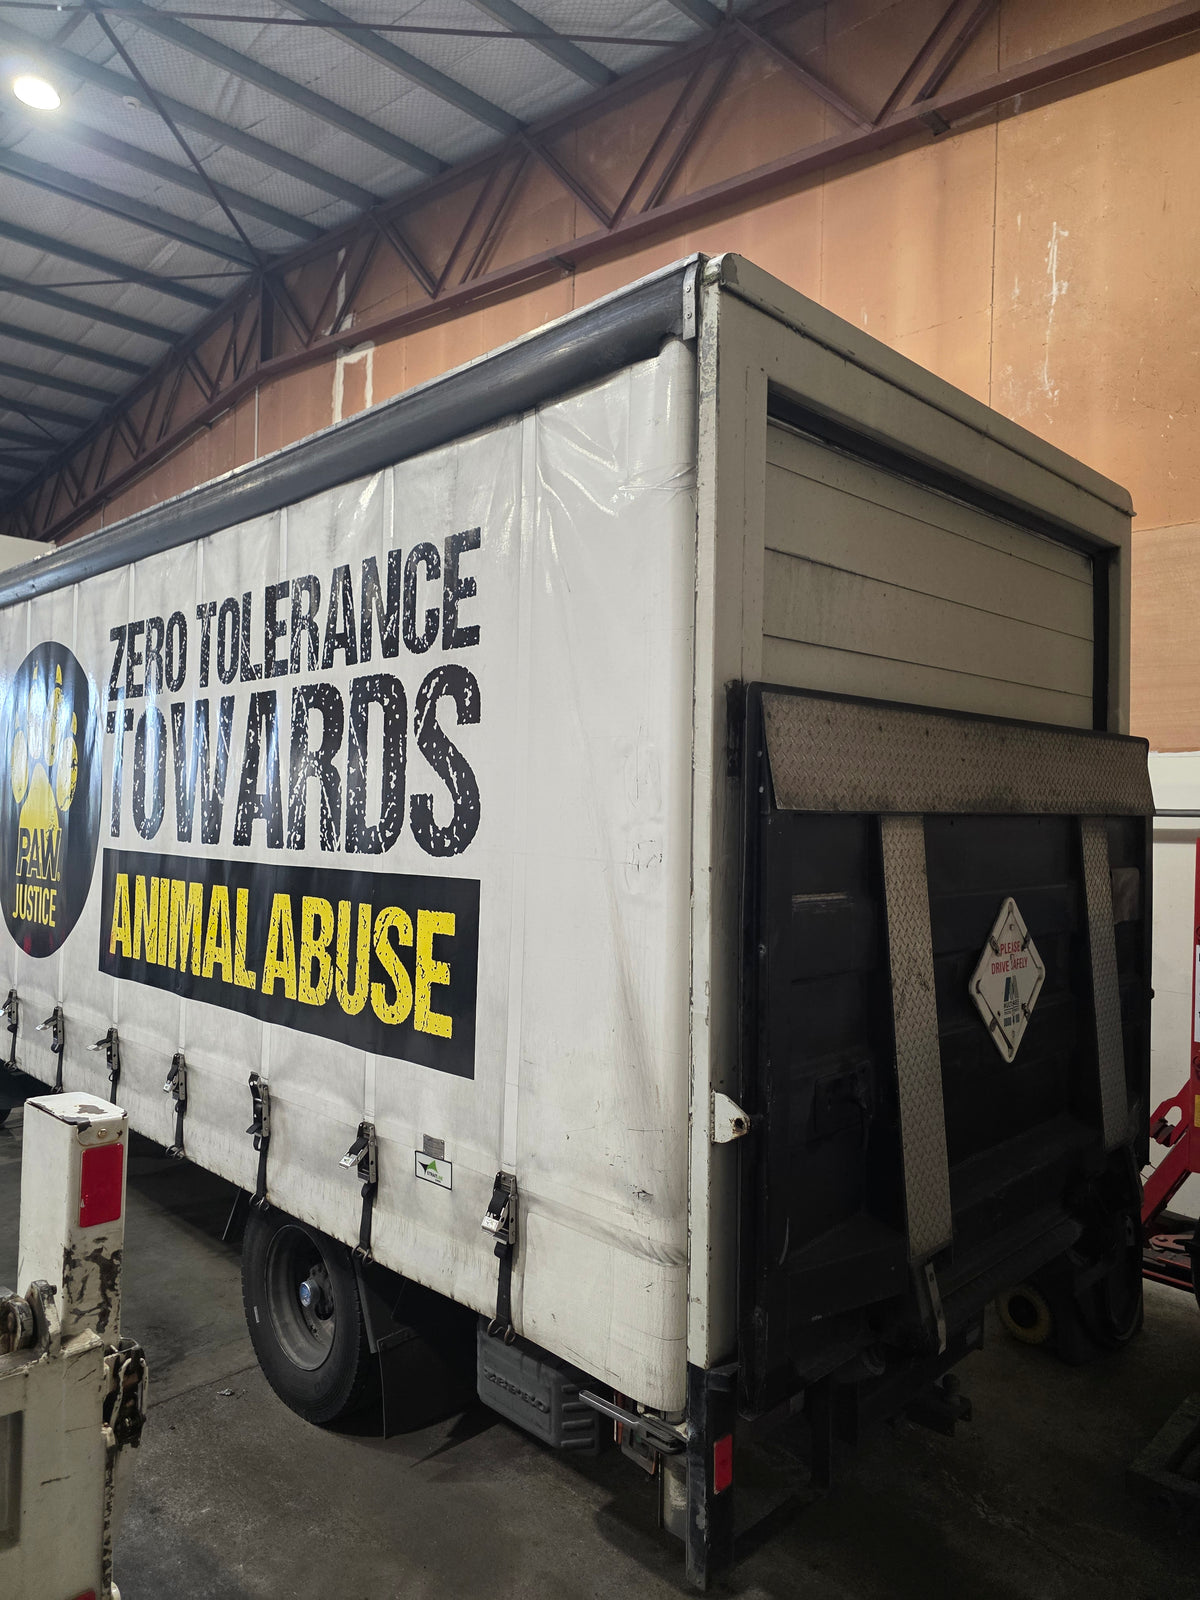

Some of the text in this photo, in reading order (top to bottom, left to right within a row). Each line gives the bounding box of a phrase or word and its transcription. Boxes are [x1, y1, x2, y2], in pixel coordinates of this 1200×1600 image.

[108, 527, 482, 700] ZERO TOLERANCE
[106, 663, 482, 857] TOWARDS
[12, 883, 57, 928] JUSTICE
[110, 872, 456, 1039] ANIMAL ABUSE
[1000, 940, 1021, 954] PLEASE
[991, 961, 1010, 974] DRIVE
